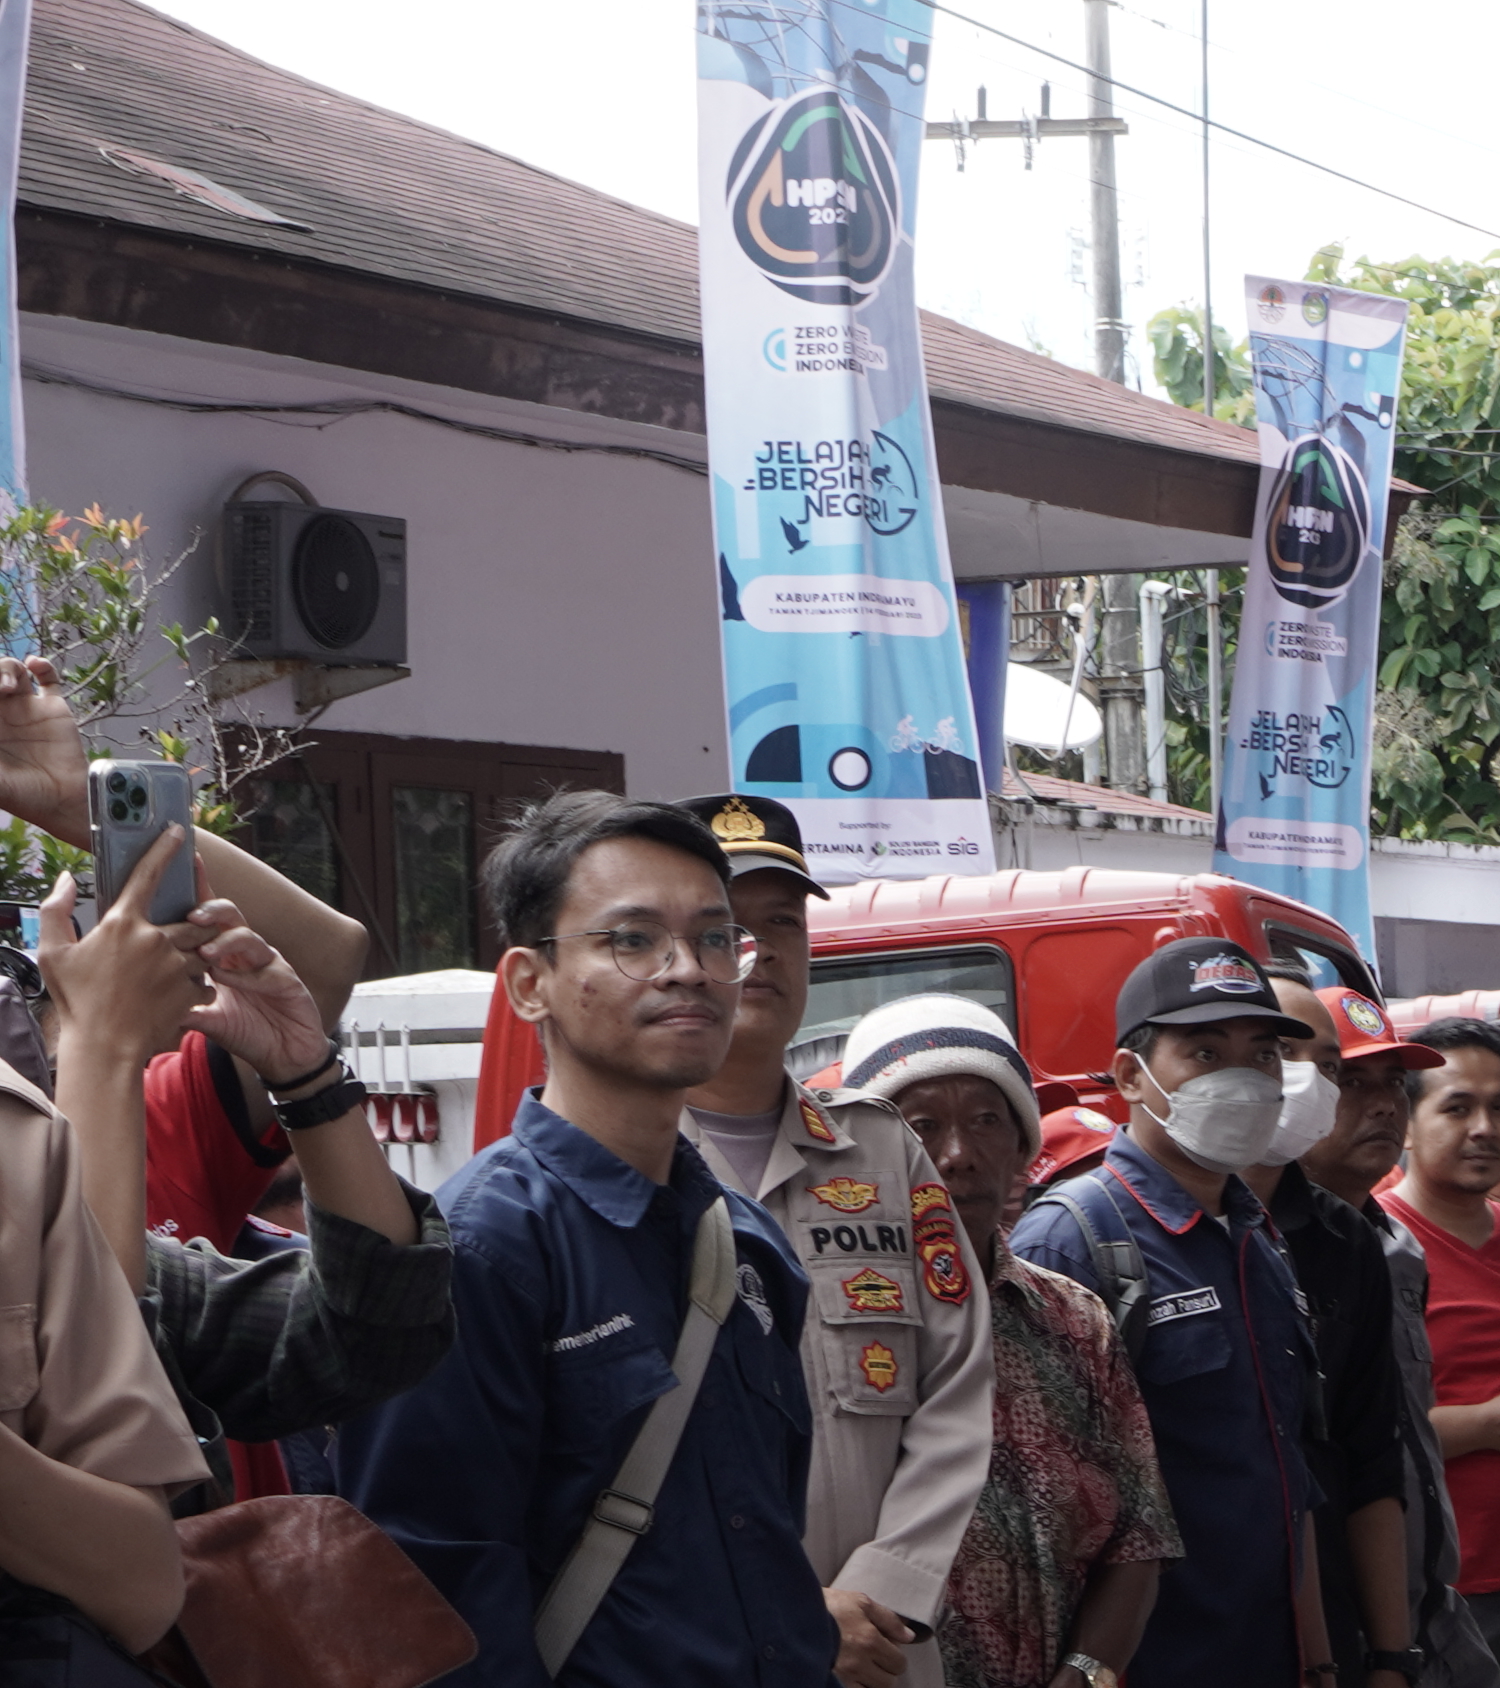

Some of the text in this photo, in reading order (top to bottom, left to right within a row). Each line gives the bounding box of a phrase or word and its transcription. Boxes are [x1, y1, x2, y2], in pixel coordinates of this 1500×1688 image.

[808, 208, 849, 225] 202
[794, 326, 837, 339] ZERO
[794, 343, 838, 355] ZERO
[758, 466, 866, 491] BERSIH
[797, 494, 889, 524] NEGERI
[775, 592, 855, 603] KABUPATEN
[801, 843, 865, 854] ERTAMINA
[809, 1225, 907, 1254] POLRI
